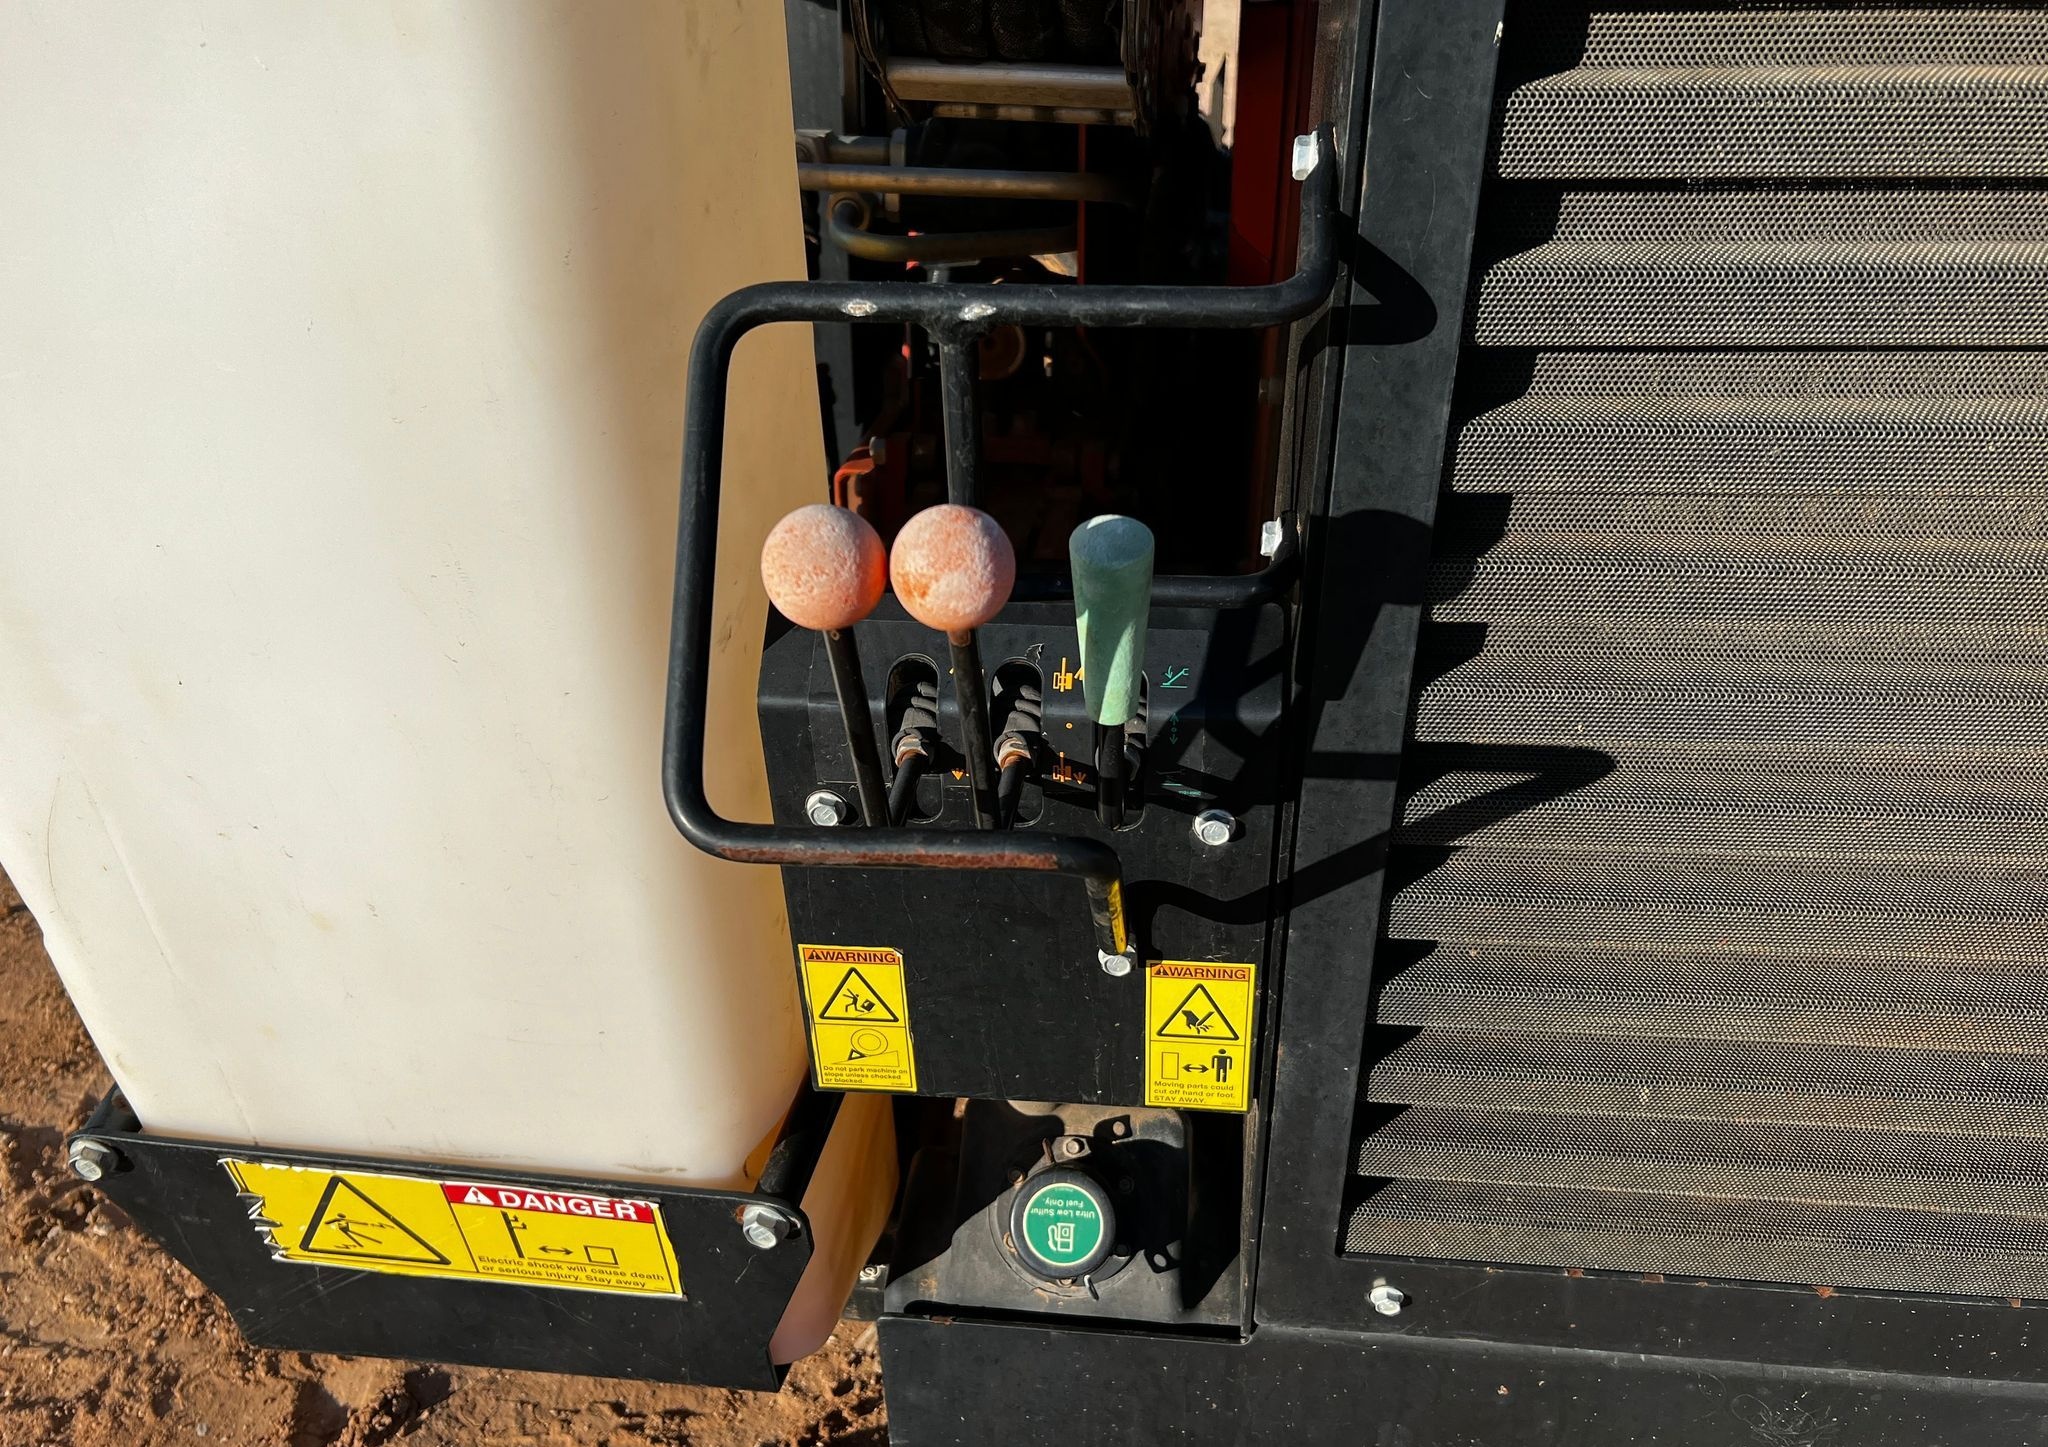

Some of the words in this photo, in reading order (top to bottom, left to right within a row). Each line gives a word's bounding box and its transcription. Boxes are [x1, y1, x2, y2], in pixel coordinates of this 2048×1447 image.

[821, 950, 896, 963] WARNING
[1169, 966, 1246, 979] WARNING
[1154, 1080, 1185, 1089] Moving
[499, 1189, 639, 1221] DANGER
[1042, 1196, 1064, 1207] Only.
[1066, 1199, 1084, 1209] Fuel
[1030, 1207, 1055, 1217] Sulfur
[1057, 1209, 1073, 1218] Low
[1075, 1210, 1095, 1219] Ultra
[478, 1255, 524, 1266] Electric
[527, 1260, 564, 1271] shock
[567, 1264, 588, 1273] will
[591, 1267, 627, 1277] cause
[630, 1271, 665, 1281] death
[498, 1266, 543, 1276] serious
[545, 1271, 583, 1281] injury.
[585, 1273, 612, 1285] Stay
[616, 1278, 646, 1288] away
